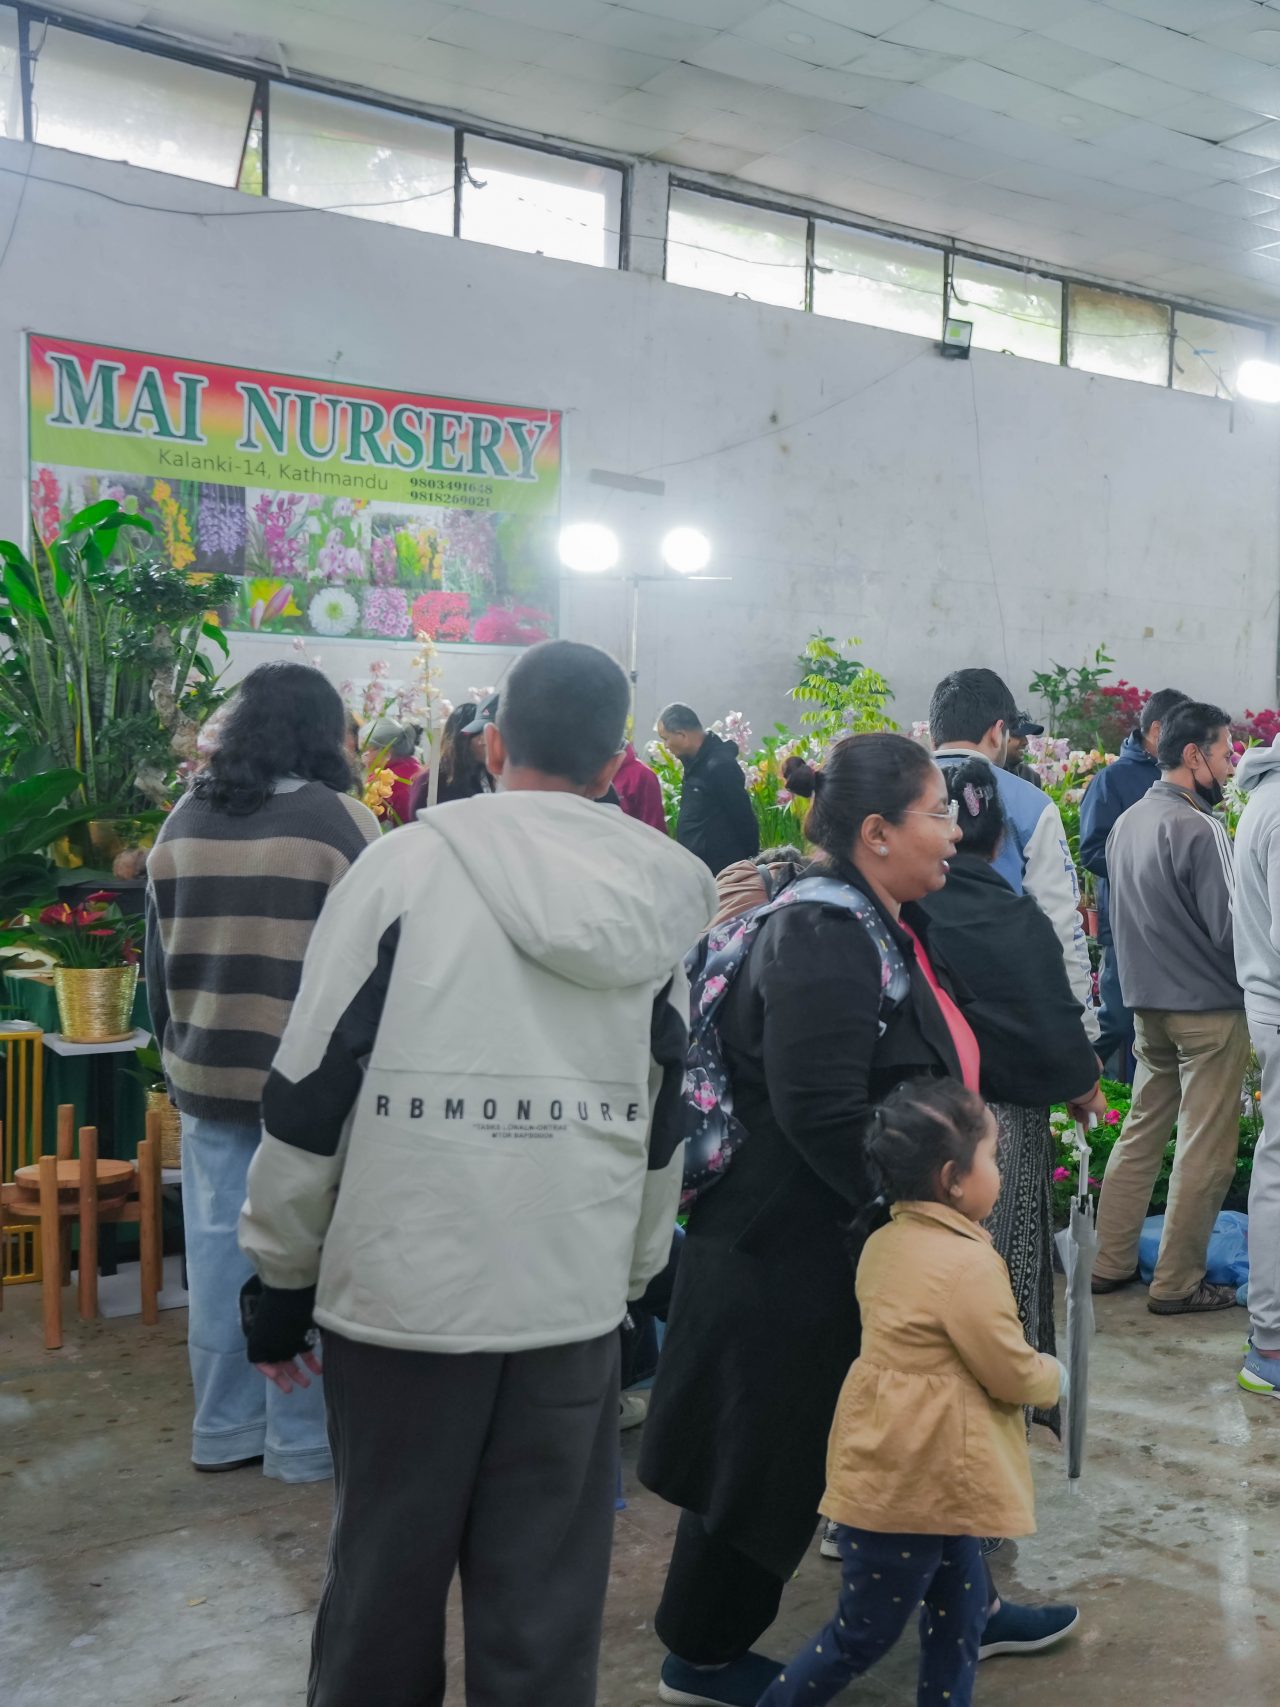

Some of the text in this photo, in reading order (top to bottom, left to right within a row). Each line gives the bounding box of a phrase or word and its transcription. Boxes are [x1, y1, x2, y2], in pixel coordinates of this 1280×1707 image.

[49, 355, 547, 480] MAI NURSERY
[280, 464, 388, 490] Kathmandu
[375, 1094, 640, 1122] RBMONOURE
